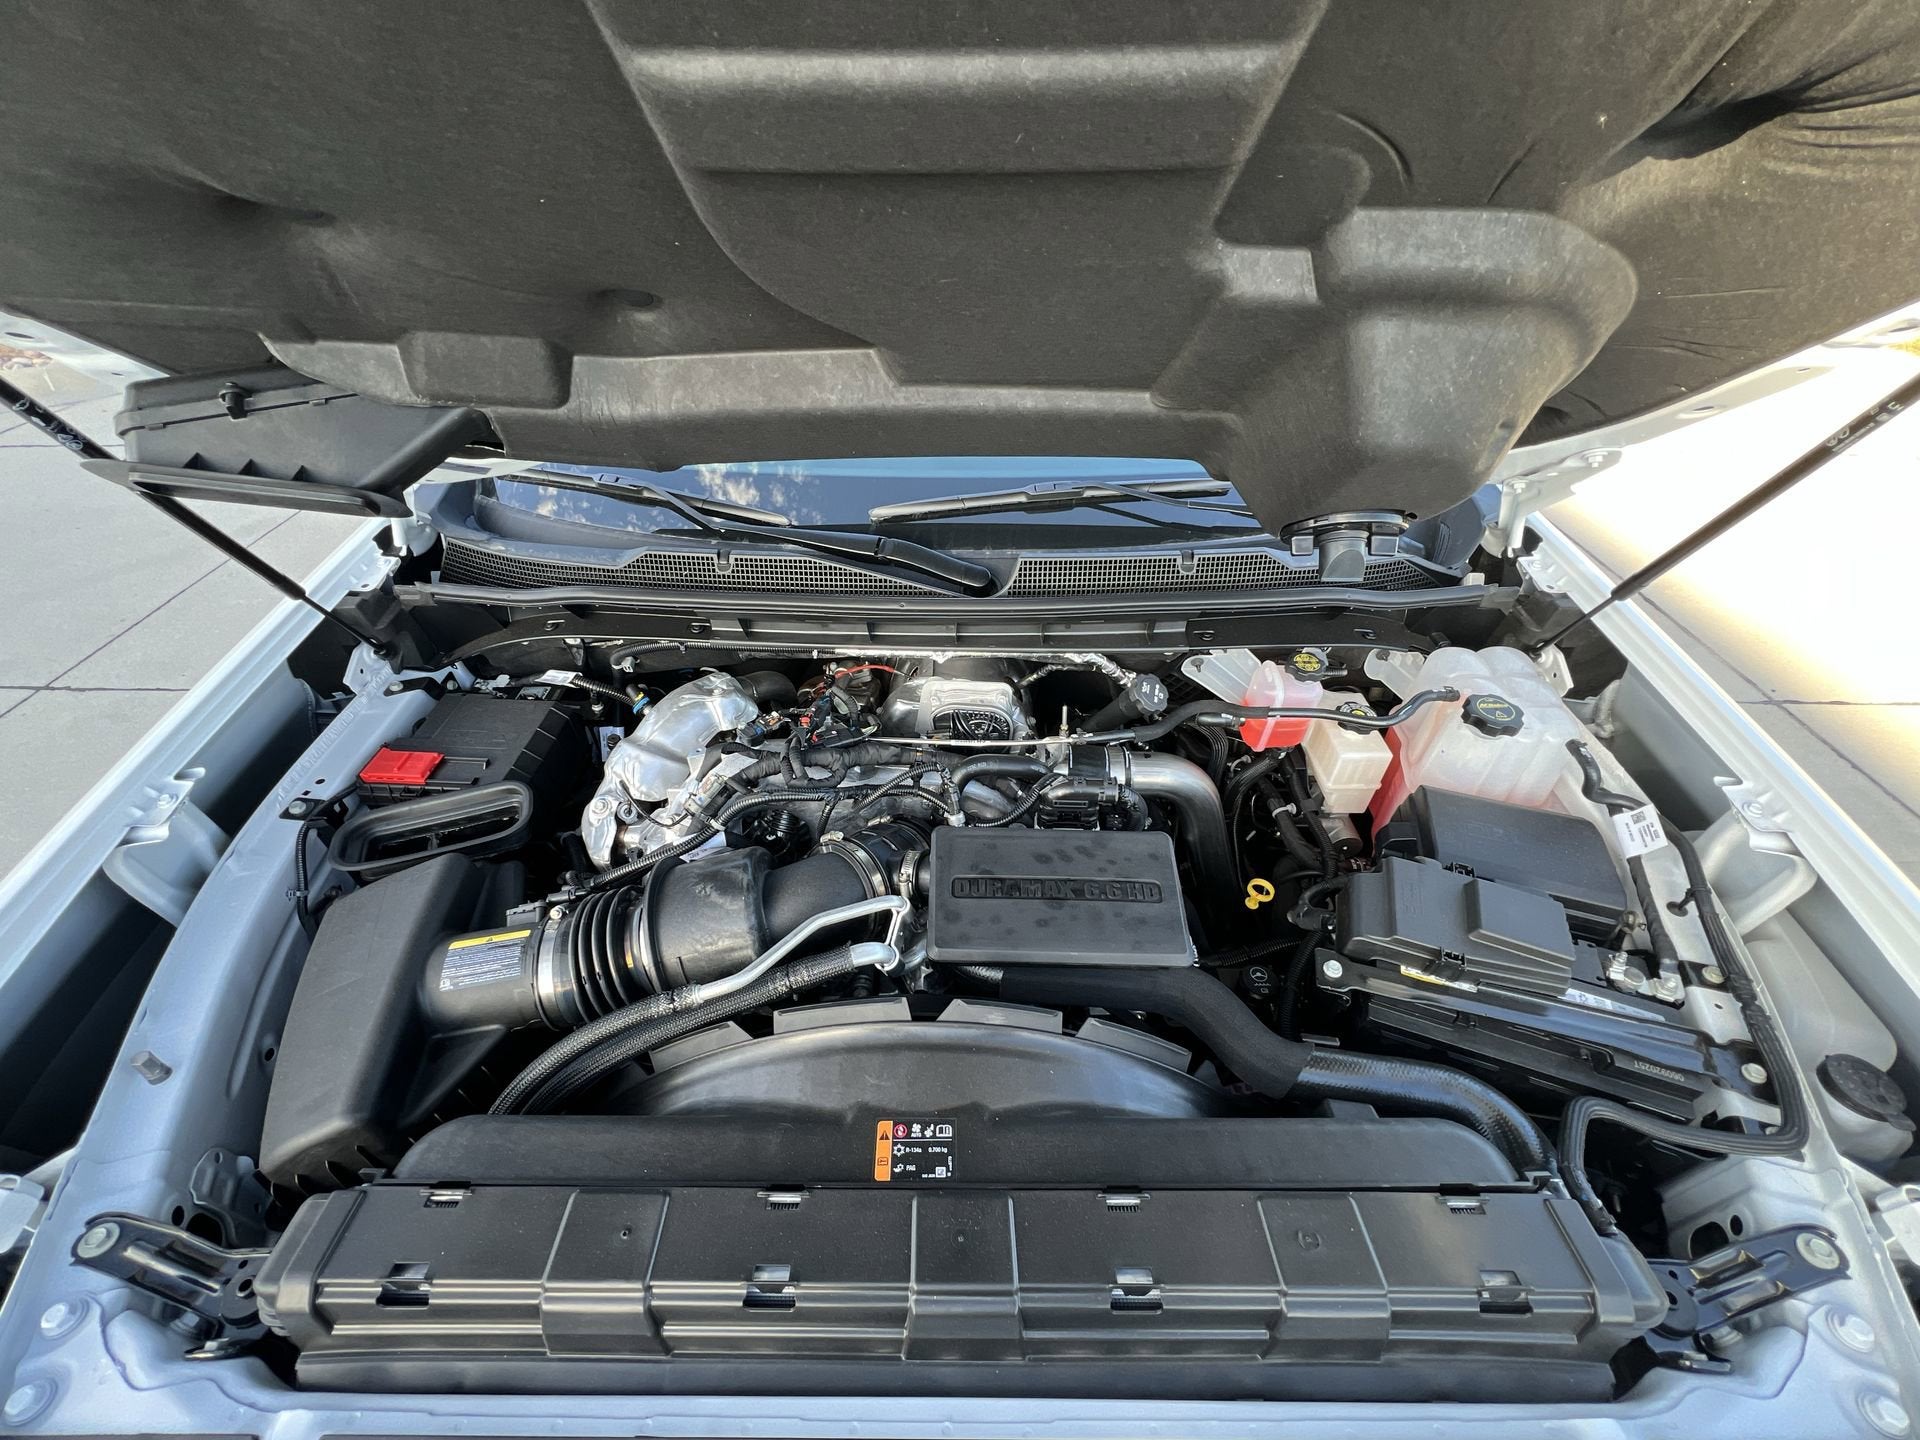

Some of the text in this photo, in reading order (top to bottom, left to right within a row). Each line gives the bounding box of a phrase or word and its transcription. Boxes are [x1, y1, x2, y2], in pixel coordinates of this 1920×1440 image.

[955, 878, 1161, 901] DURAMAX 6.6 HD
